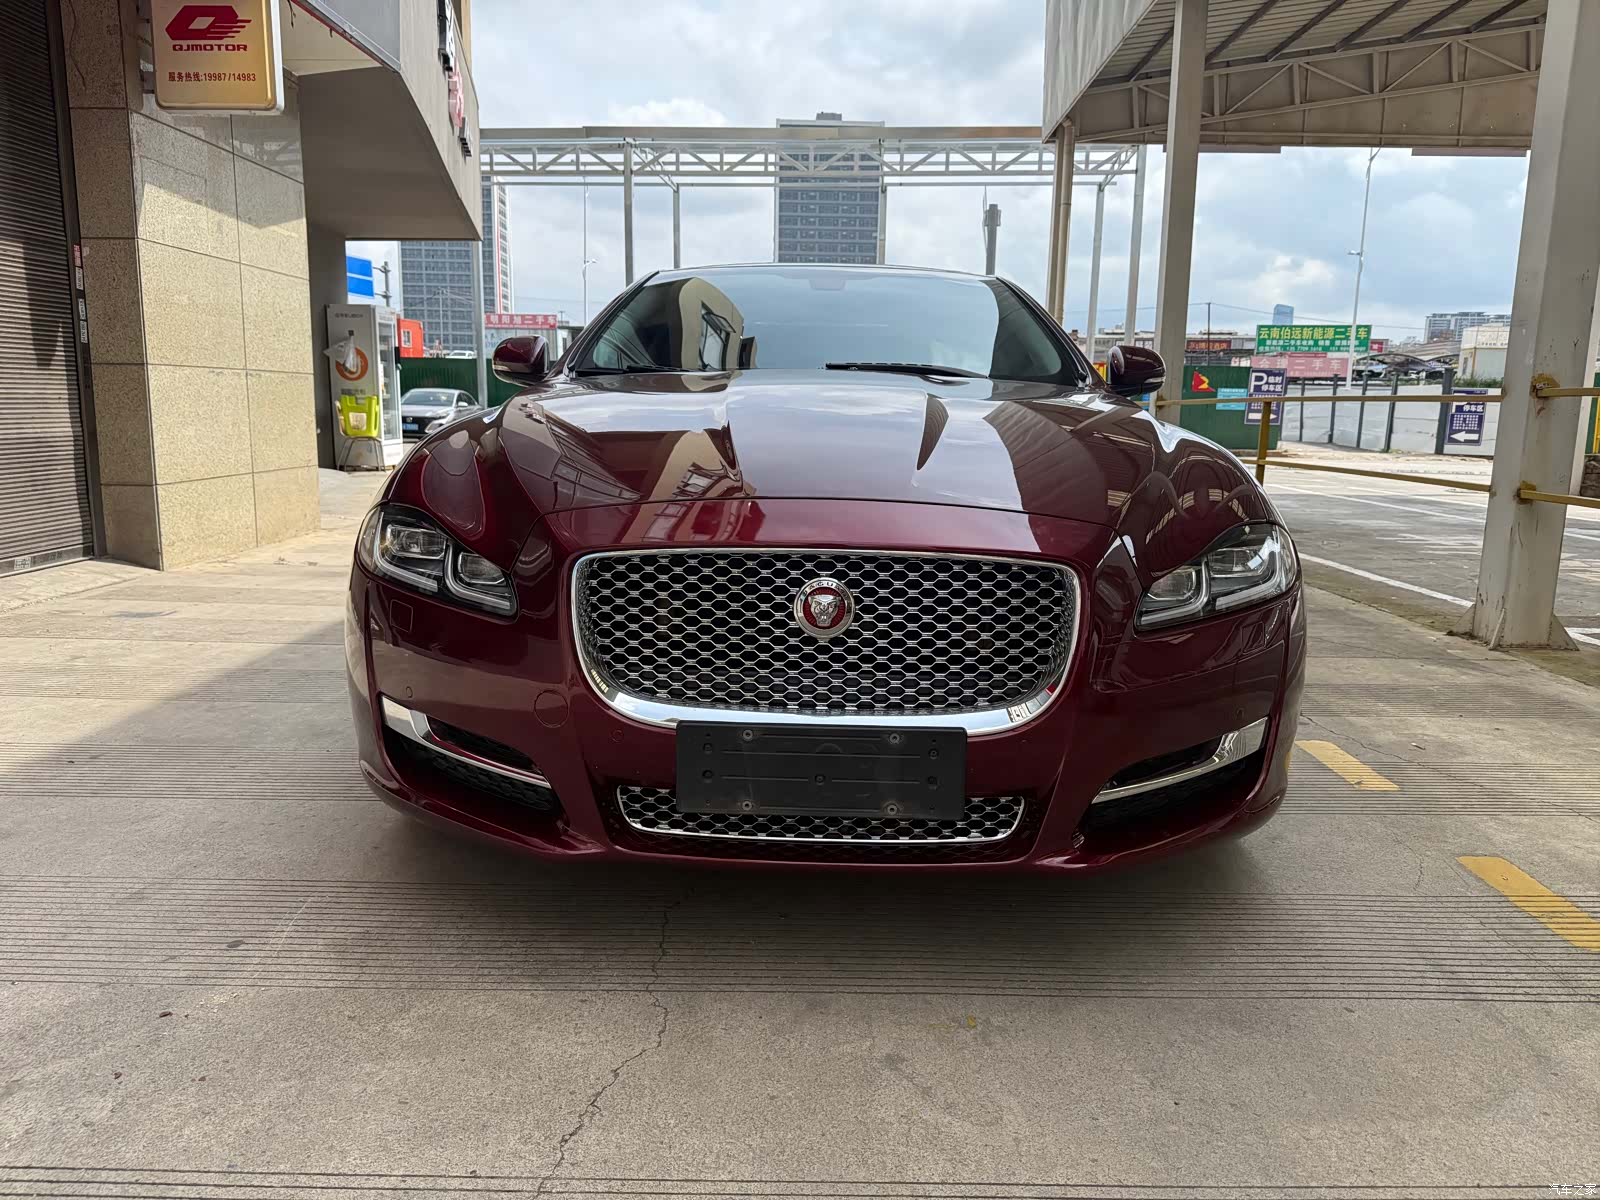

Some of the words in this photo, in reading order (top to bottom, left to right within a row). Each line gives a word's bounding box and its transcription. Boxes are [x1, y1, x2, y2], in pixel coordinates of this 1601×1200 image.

[172, 44, 248, 52] QJMOTOR
[168, 72, 257, 82] 服务热线:19987/14983
[1463, 404, 1484, 412] 停车区
